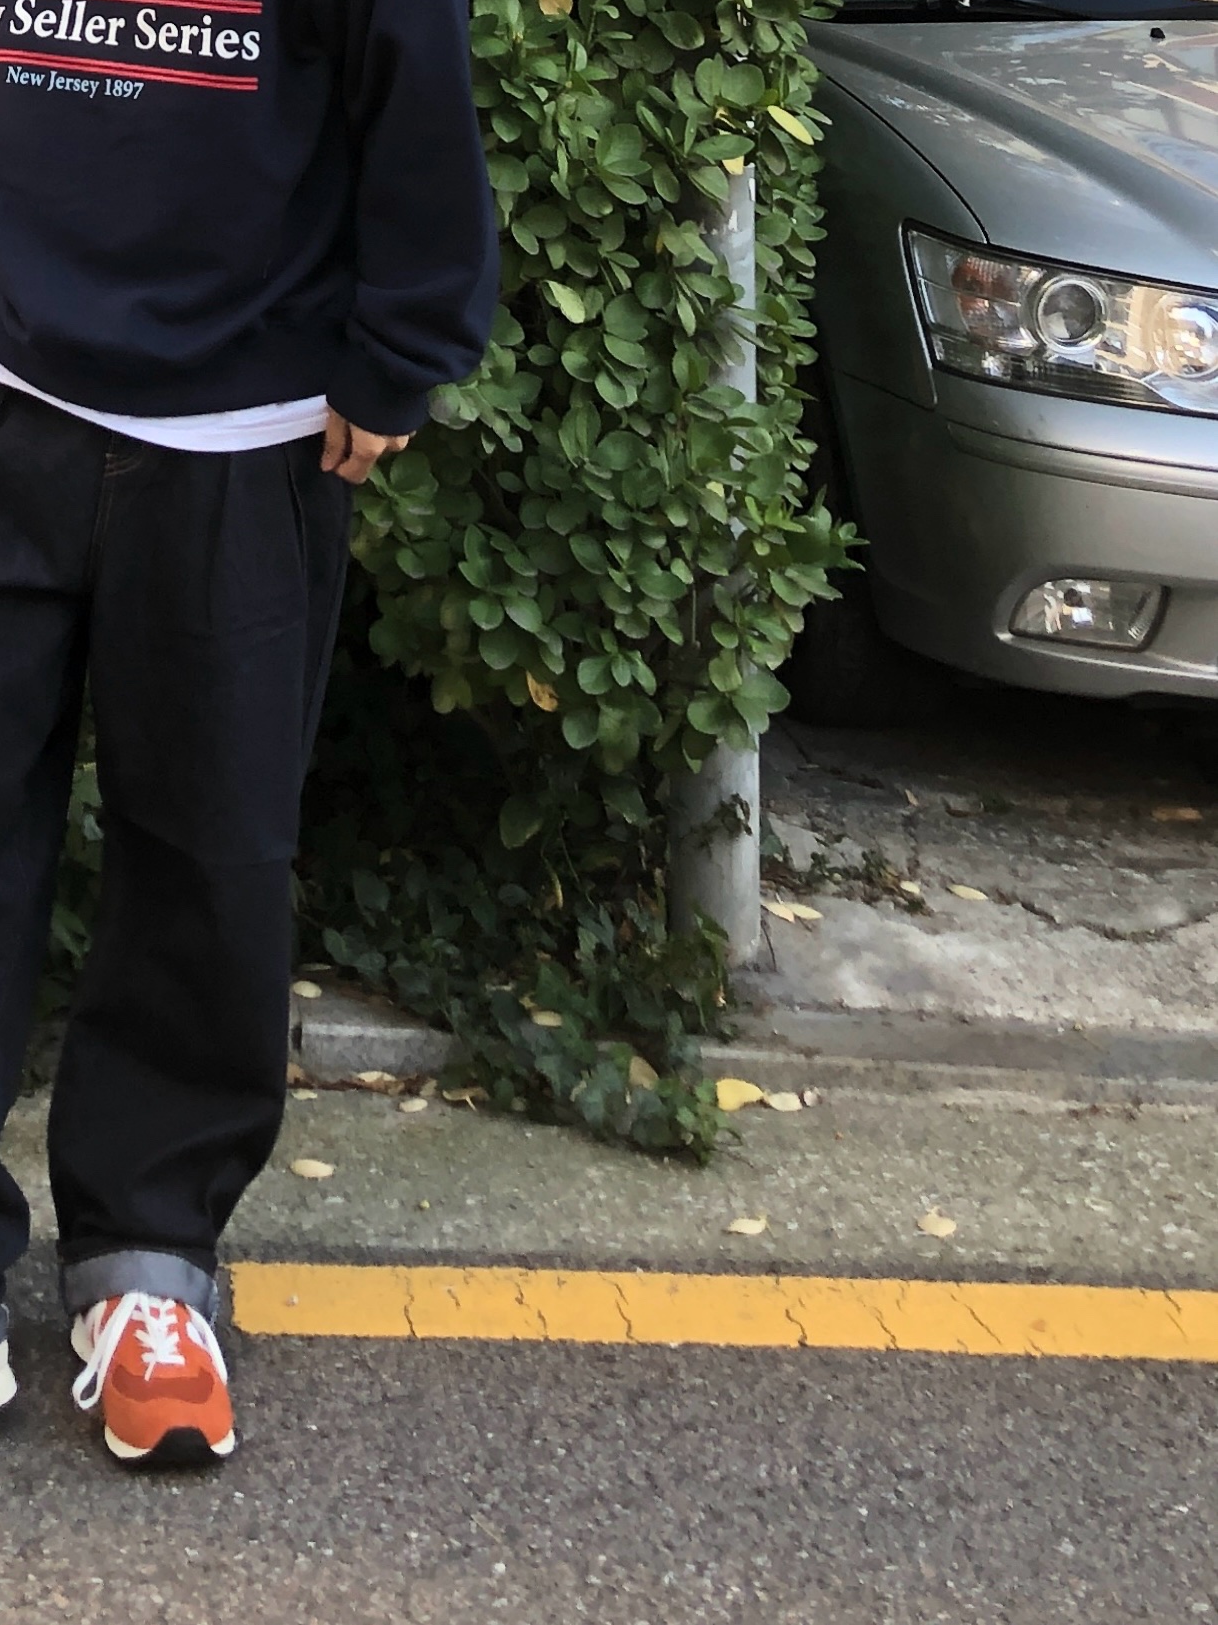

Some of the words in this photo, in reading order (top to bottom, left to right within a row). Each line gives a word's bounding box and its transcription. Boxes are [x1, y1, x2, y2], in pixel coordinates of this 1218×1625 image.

[134, 7, 261, 62] Series
[5, 65, 45, 88] New
[47, 70, 99, 99] Jersey
[103, 78, 144, 100] 1897
